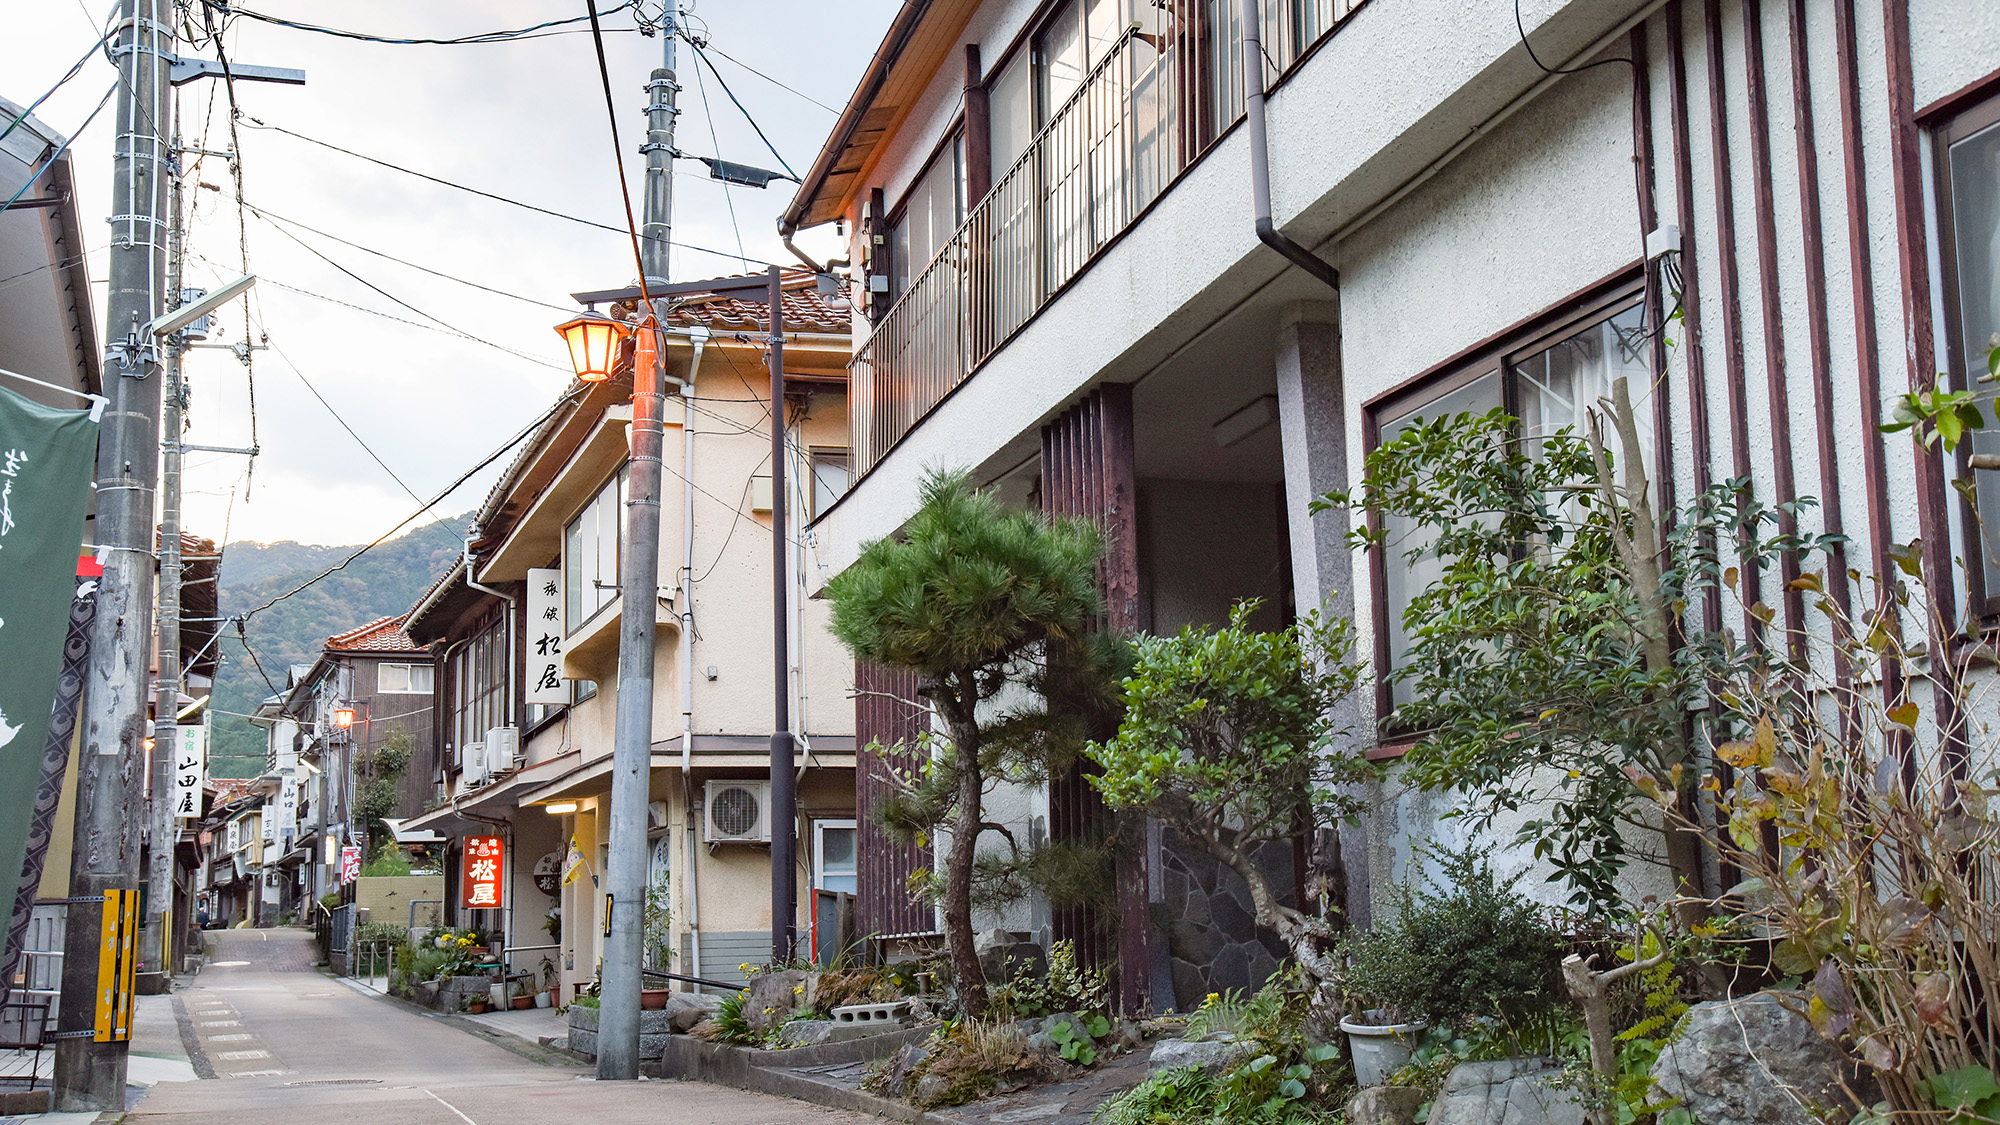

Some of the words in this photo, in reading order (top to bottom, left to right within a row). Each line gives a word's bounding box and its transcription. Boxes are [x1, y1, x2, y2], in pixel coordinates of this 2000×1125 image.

[534, 632, 561, 693] 松屋
[185, 728, 195, 751] お宿
[178, 756, 198, 813] 山田屋
[468, 859, 498, 905] 松屋
